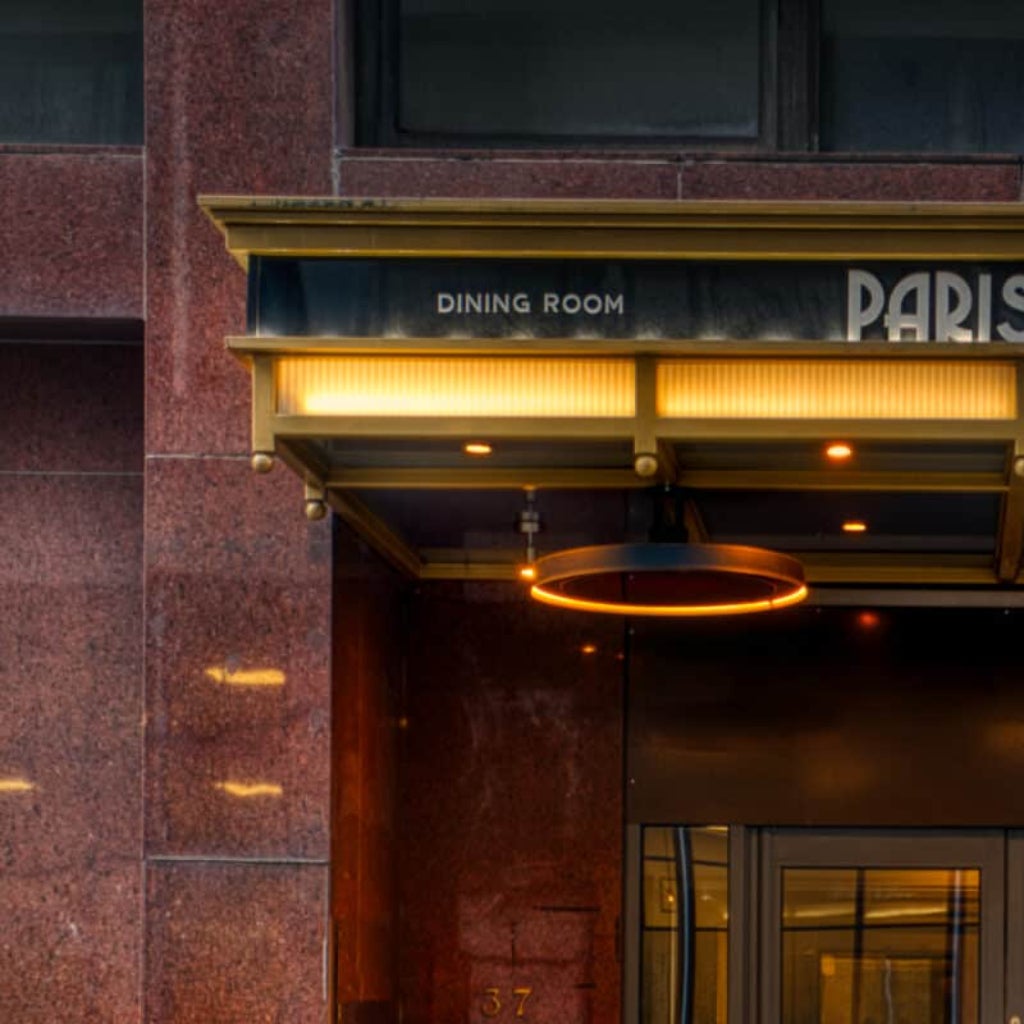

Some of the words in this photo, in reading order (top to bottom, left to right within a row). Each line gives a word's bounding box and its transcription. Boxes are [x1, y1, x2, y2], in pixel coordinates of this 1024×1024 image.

[436, 293, 531, 315] DINING
[543, 293, 624, 315] ROOM
[482, 986, 533, 1017] 37
